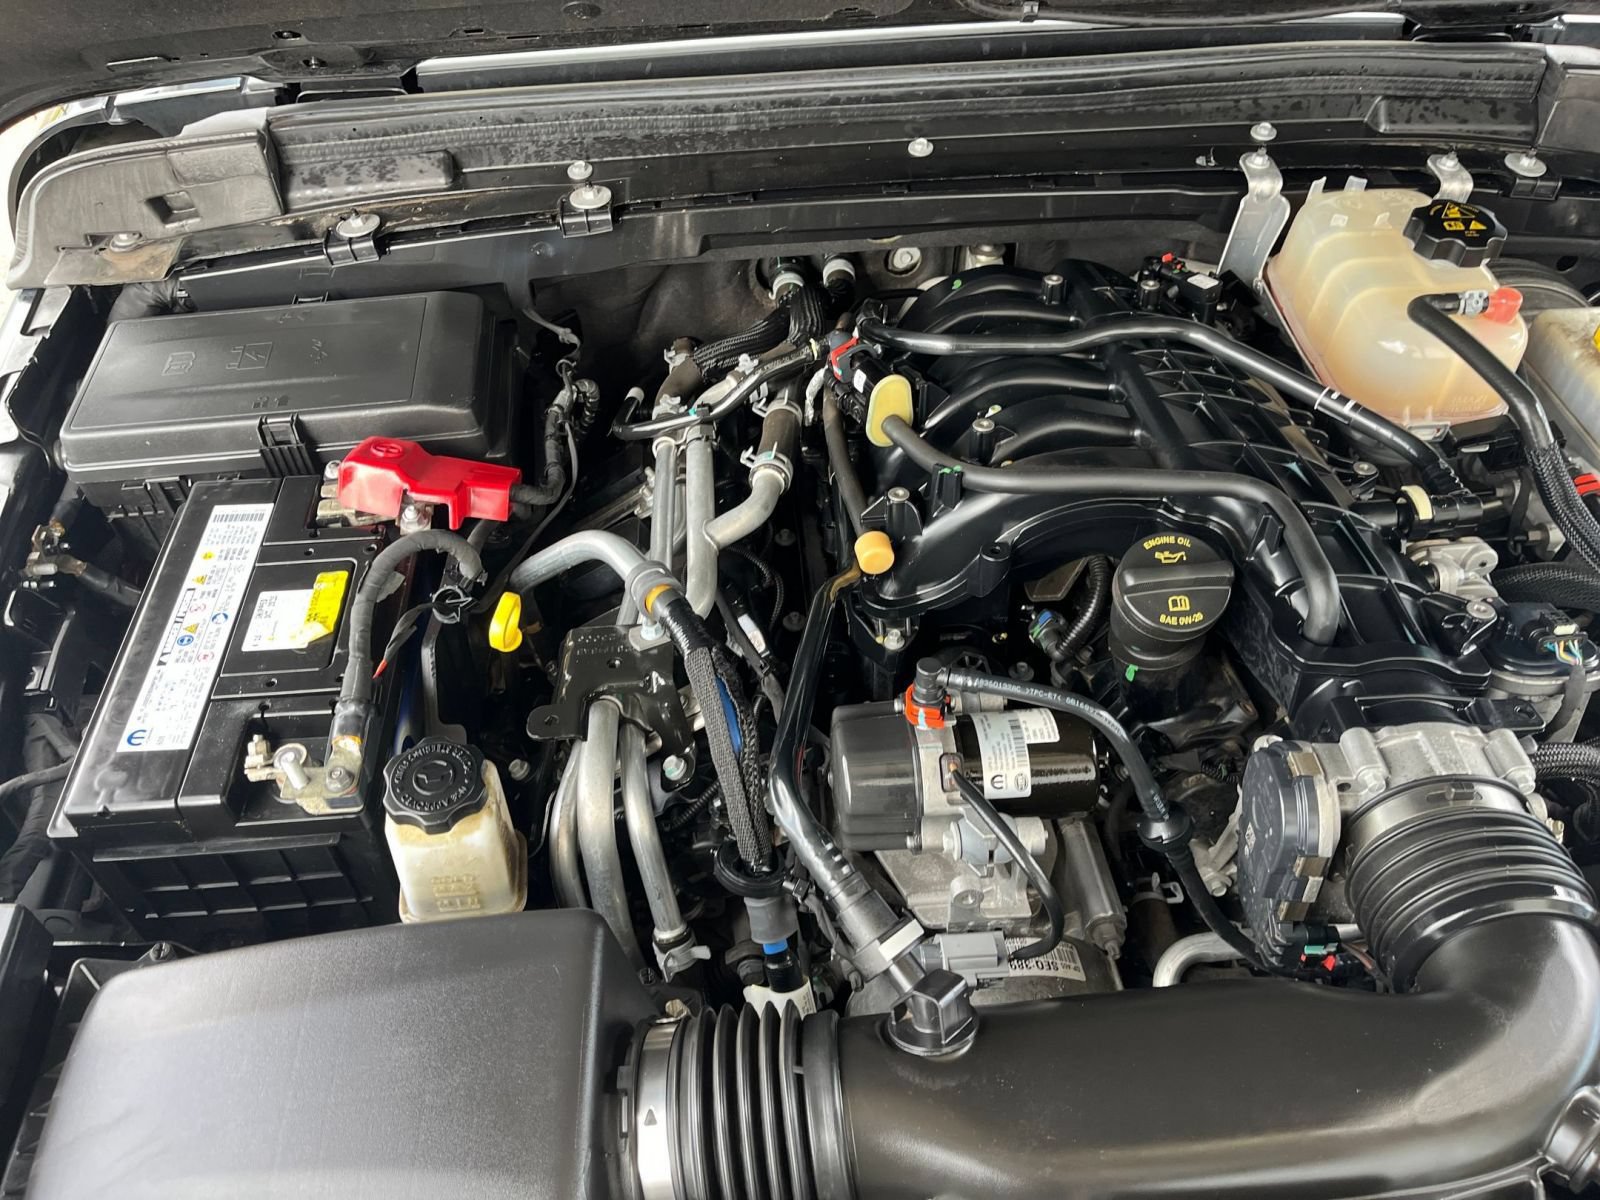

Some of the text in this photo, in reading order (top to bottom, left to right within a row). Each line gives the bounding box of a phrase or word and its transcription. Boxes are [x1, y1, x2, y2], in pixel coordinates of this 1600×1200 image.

[1143, 536, 1191, 550] ENGINE OIL
[1159, 613, 1178, 626] SAE
